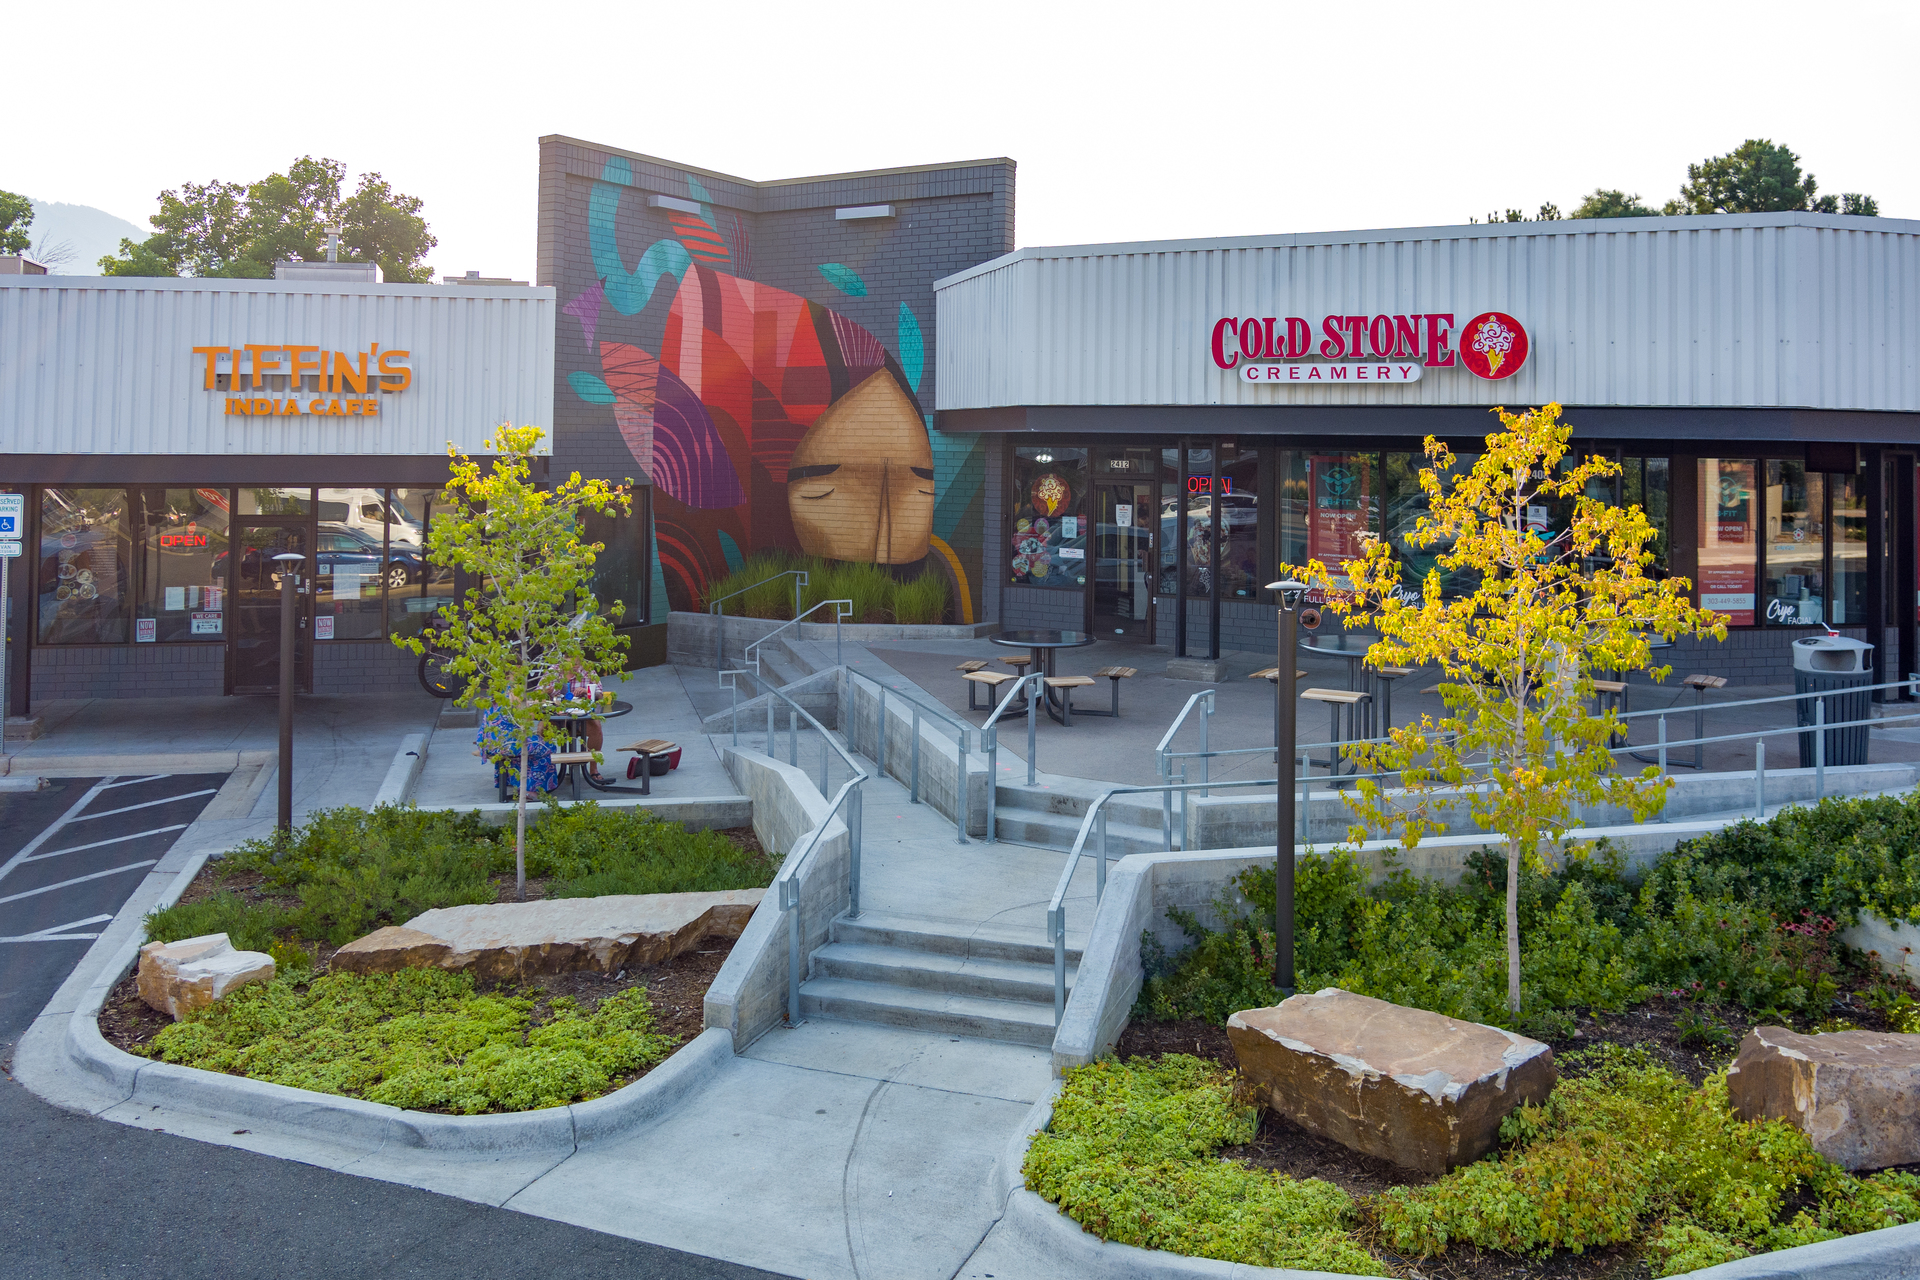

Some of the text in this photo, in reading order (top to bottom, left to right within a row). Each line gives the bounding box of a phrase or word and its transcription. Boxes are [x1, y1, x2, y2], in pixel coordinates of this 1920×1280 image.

[1211, 313, 1456, 370] COLD STONE
[192, 342, 412, 394] TIFFIN'S
[1246, 366, 1413, 380] CREAMERY
[224, 398, 379, 416] INDIA CAFE
[1111, 460, 1129, 468] 2412
[1188, 477, 1230, 494] OPN
[161, 535, 206, 546] OPEN
[1303, 595, 1324, 604] FULL
[1707, 597, 1747, 605] 303-449-5855
[1766, 599, 1796, 622] Cryo
[140, 621, 153, 630] NOW
[318, 619, 331, 627] NOW
[1787, 617, 1814, 625] FACIAL
